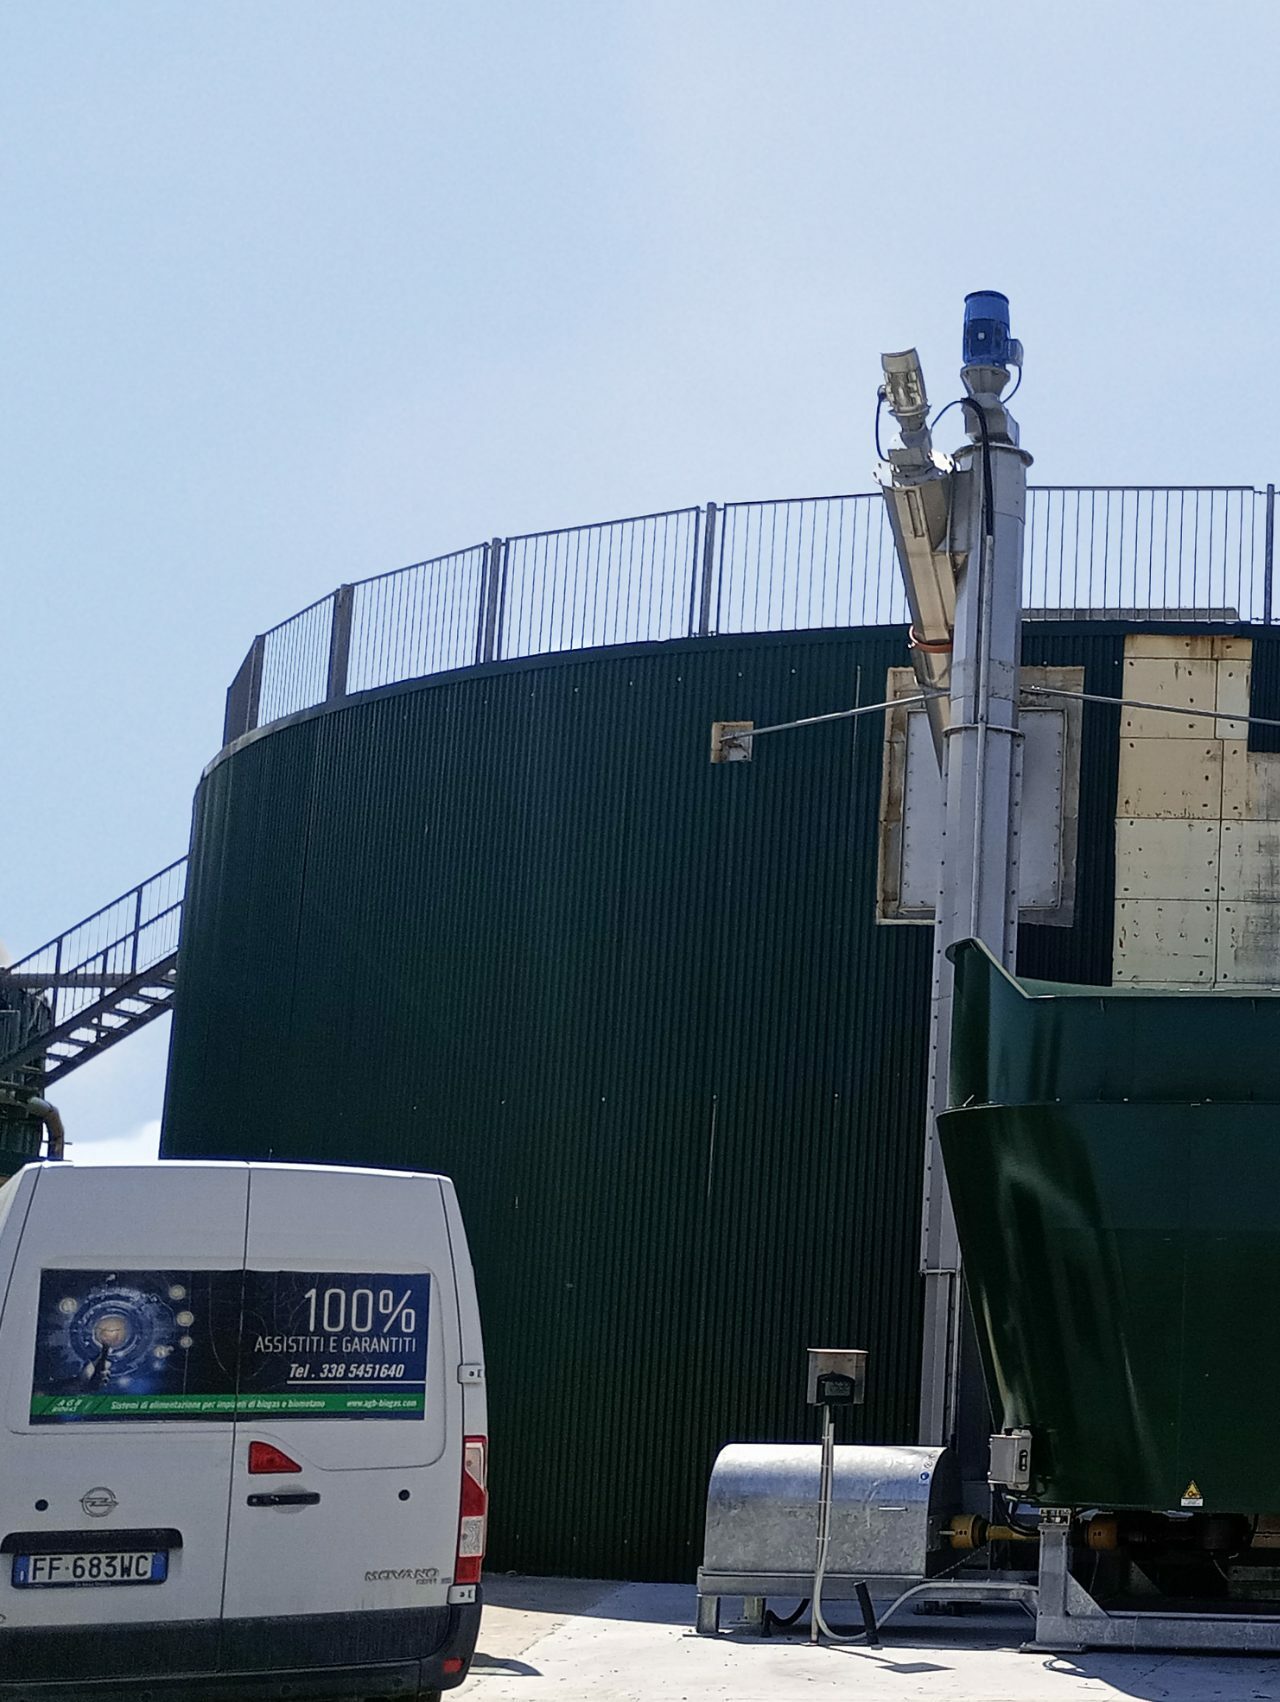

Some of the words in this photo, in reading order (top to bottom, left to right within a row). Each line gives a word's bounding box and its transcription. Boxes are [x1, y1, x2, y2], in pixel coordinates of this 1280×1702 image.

[304, 1288, 416, 1333] 100%
[254, 1336, 324, 1353] ASSISTITI
[329, 1336, 338, 1353] E
[342, 1337, 417, 1353] GARANTITI
[319, 1364, 346, 1378] 338
[348, 1364, 405, 1378] 5451640
[111, 1400, 139, 1410] Sistemi
[256, 1399, 280, 1409] biogas
[346, 1399, 418, 1409] www.agb-biogas.com
[364, 1568, 440, 1581] MOVANO
